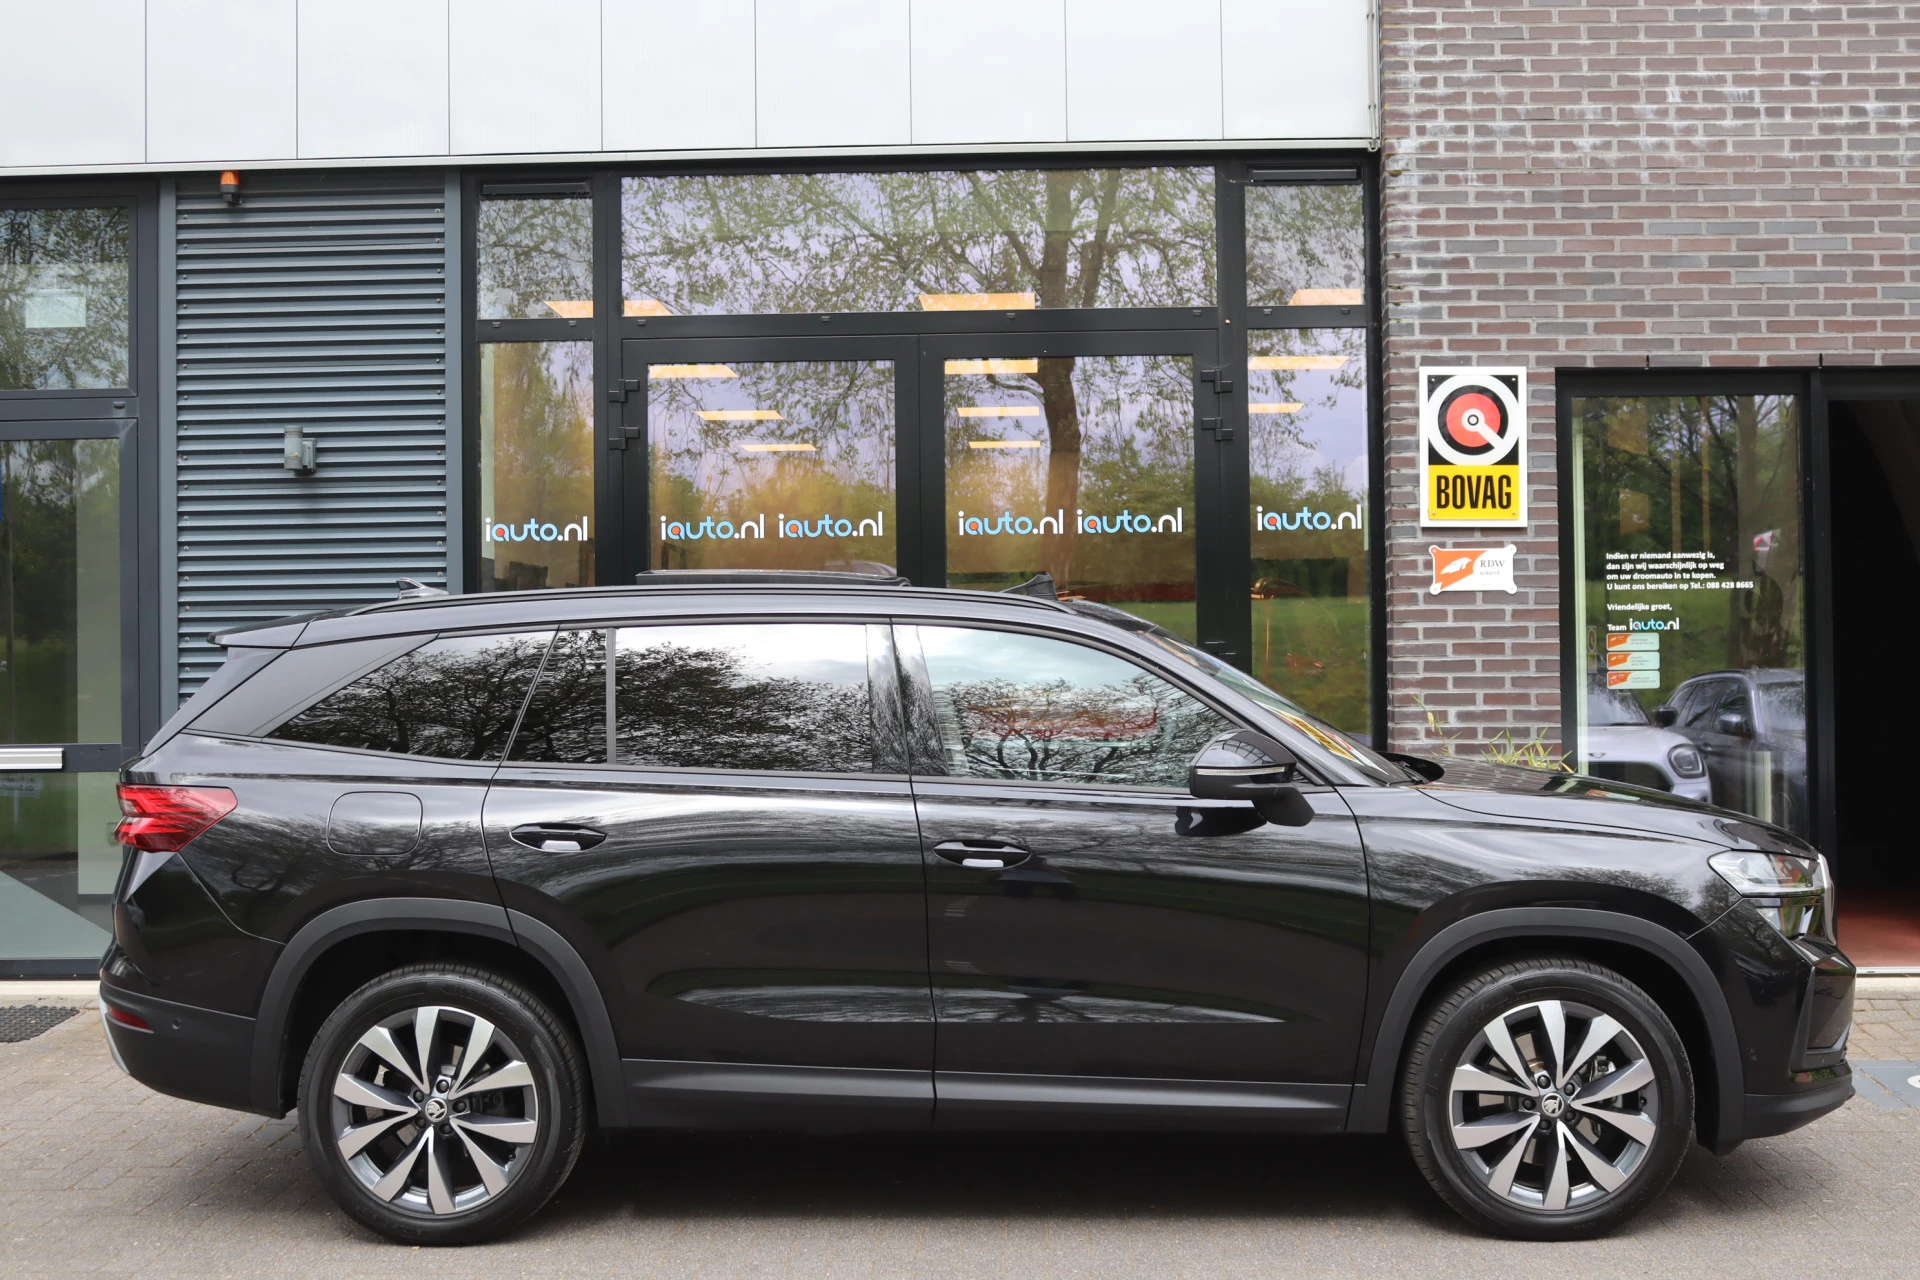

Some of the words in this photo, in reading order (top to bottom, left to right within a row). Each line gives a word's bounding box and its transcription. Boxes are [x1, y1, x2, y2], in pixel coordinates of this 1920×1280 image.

[1436, 474, 1512, 509] BOVAG
[958, 509, 1064, 536] iauto.nl
[1076, 507, 1183, 534] iauto.nl
[1256, 504, 1363, 531] iauto.nl
[485, 515, 588, 542] iauto.nl
[660, 513, 765, 541] iauto.nl
[778, 511, 884, 538] iauto.nl
[1673, 551, 1706, 560] aanwezig
[1707, 551, 1715, 559] is,
[1480, 559, 1506, 568] RDW
[1621, 563, 1634, 571] zijn
[1636, 562, 1647, 571] wij
[1648, 562, 1697, 571] waarschijnlijk
[1698, 562, 1708, 570] op
[1709, 562, 1725, 570] weg
[1691, 572, 1716, 580] kopen.
[1736, 581, 1754, 589] 8665
[1606, 603, 1650, 611] Vriendelijke
[1650, 603, 1673, 611] groet,
[1607, 623, 1627, 631] Team
[1629, 617, 1680, 631] iauto.nl
